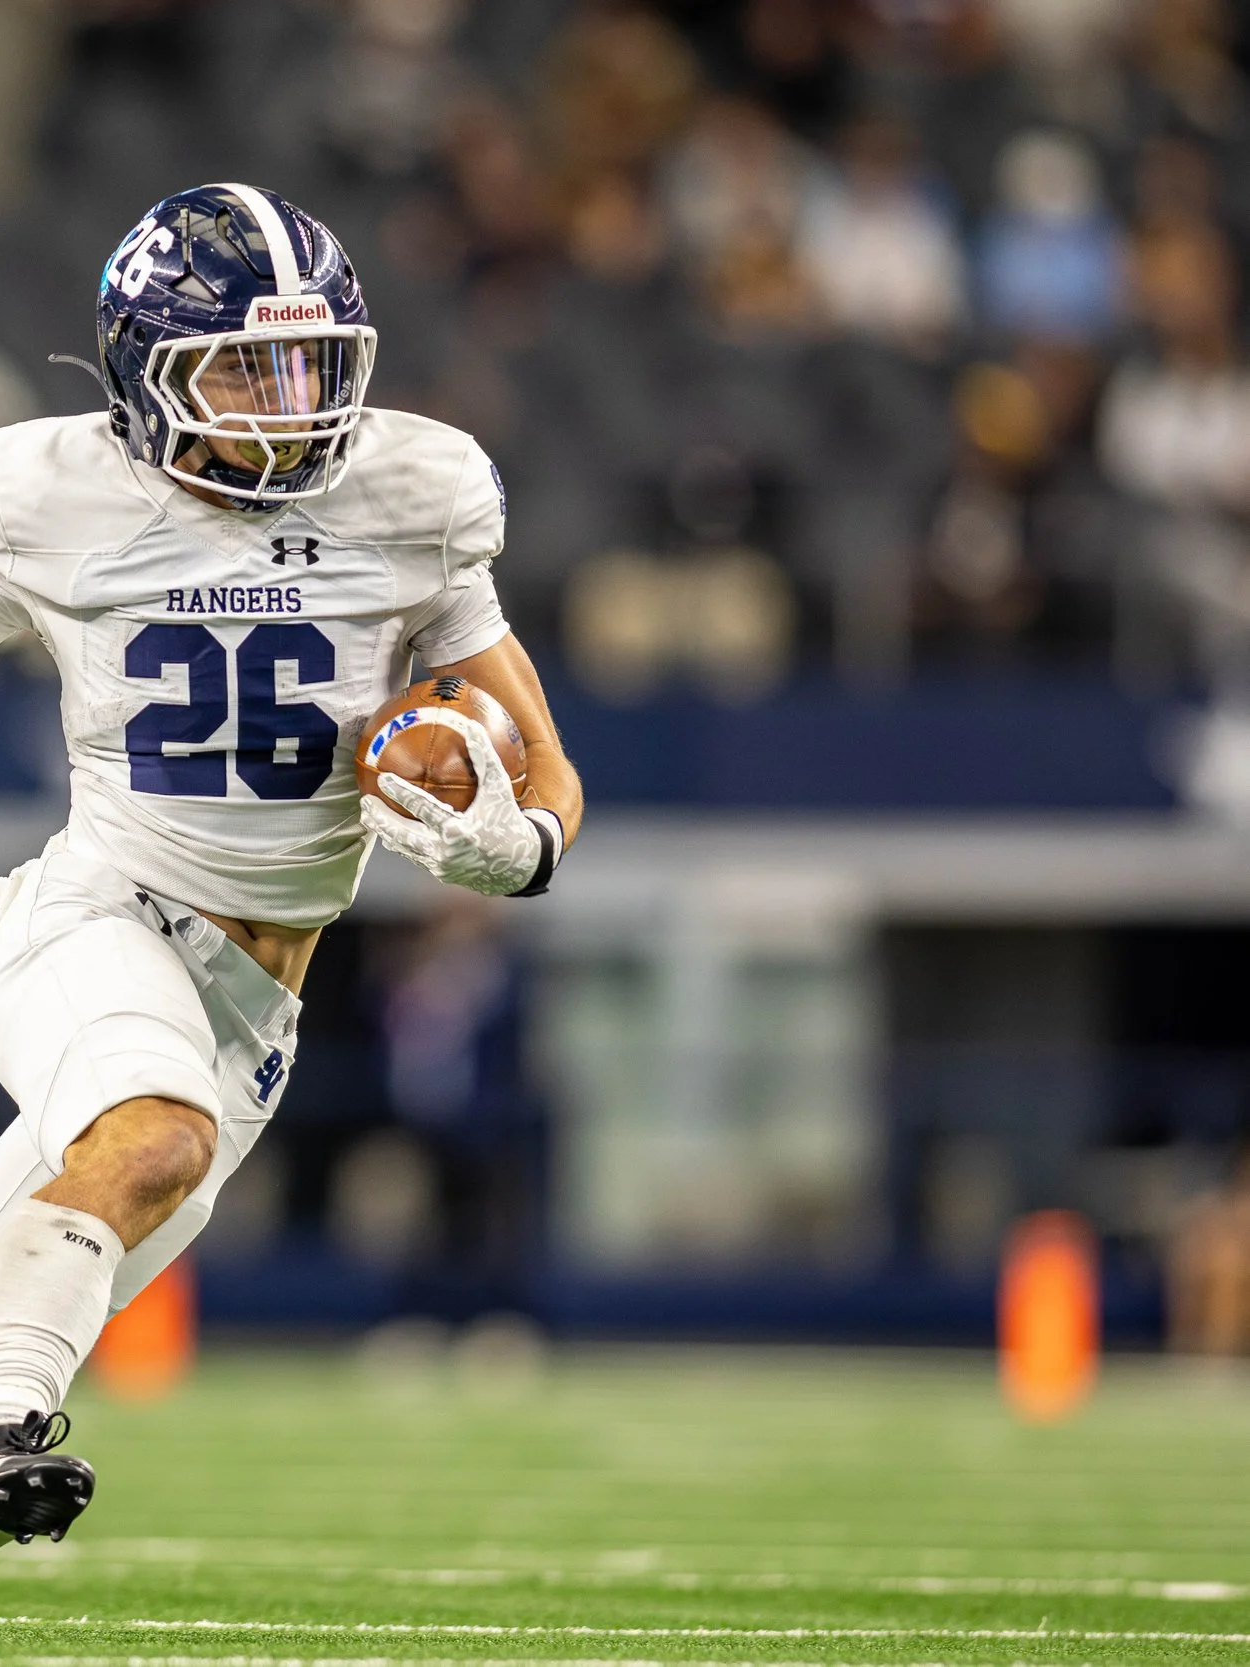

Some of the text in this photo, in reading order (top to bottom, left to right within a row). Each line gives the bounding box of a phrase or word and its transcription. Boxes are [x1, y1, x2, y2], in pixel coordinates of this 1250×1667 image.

[107, 216, 175, 300] 26
[257, 303, 327, 322] Riddell
[166, 586, 302, 613] RANGERS
[125, 621, 339, 800] 26
[63, 1230, 103, 1257] NXTRND
